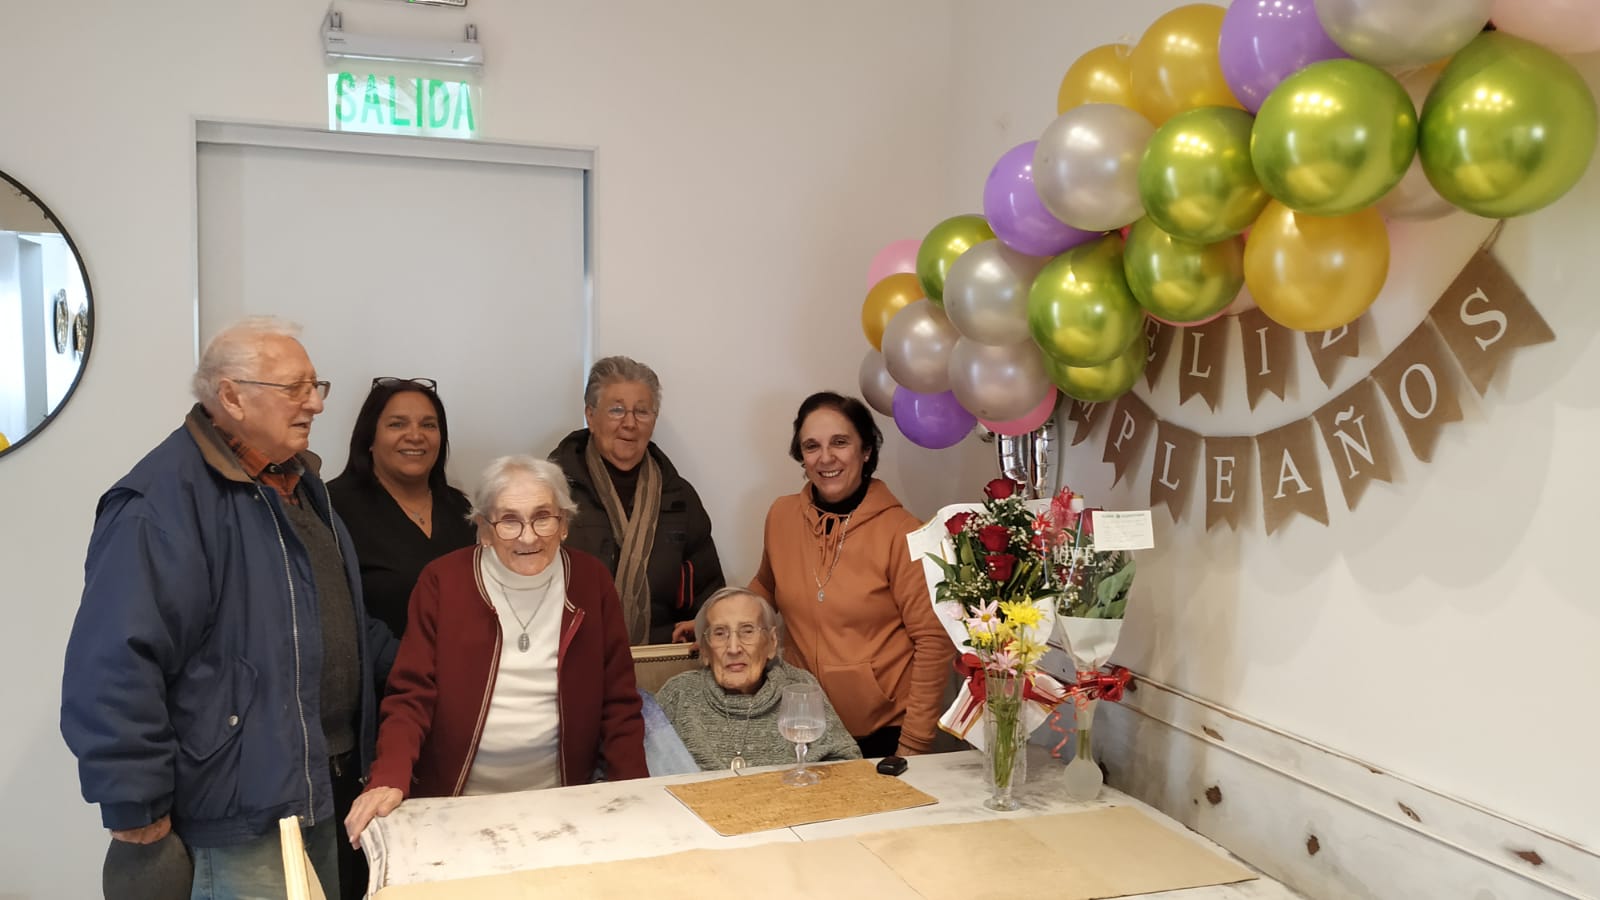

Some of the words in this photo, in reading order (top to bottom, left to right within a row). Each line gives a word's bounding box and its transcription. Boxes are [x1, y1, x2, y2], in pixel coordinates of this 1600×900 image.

[335, 71, 475, 131] SALIDA
[1145, 316, 1348, 378] ELI
[1078, 287, 1508, 503] PLEAÑOS
